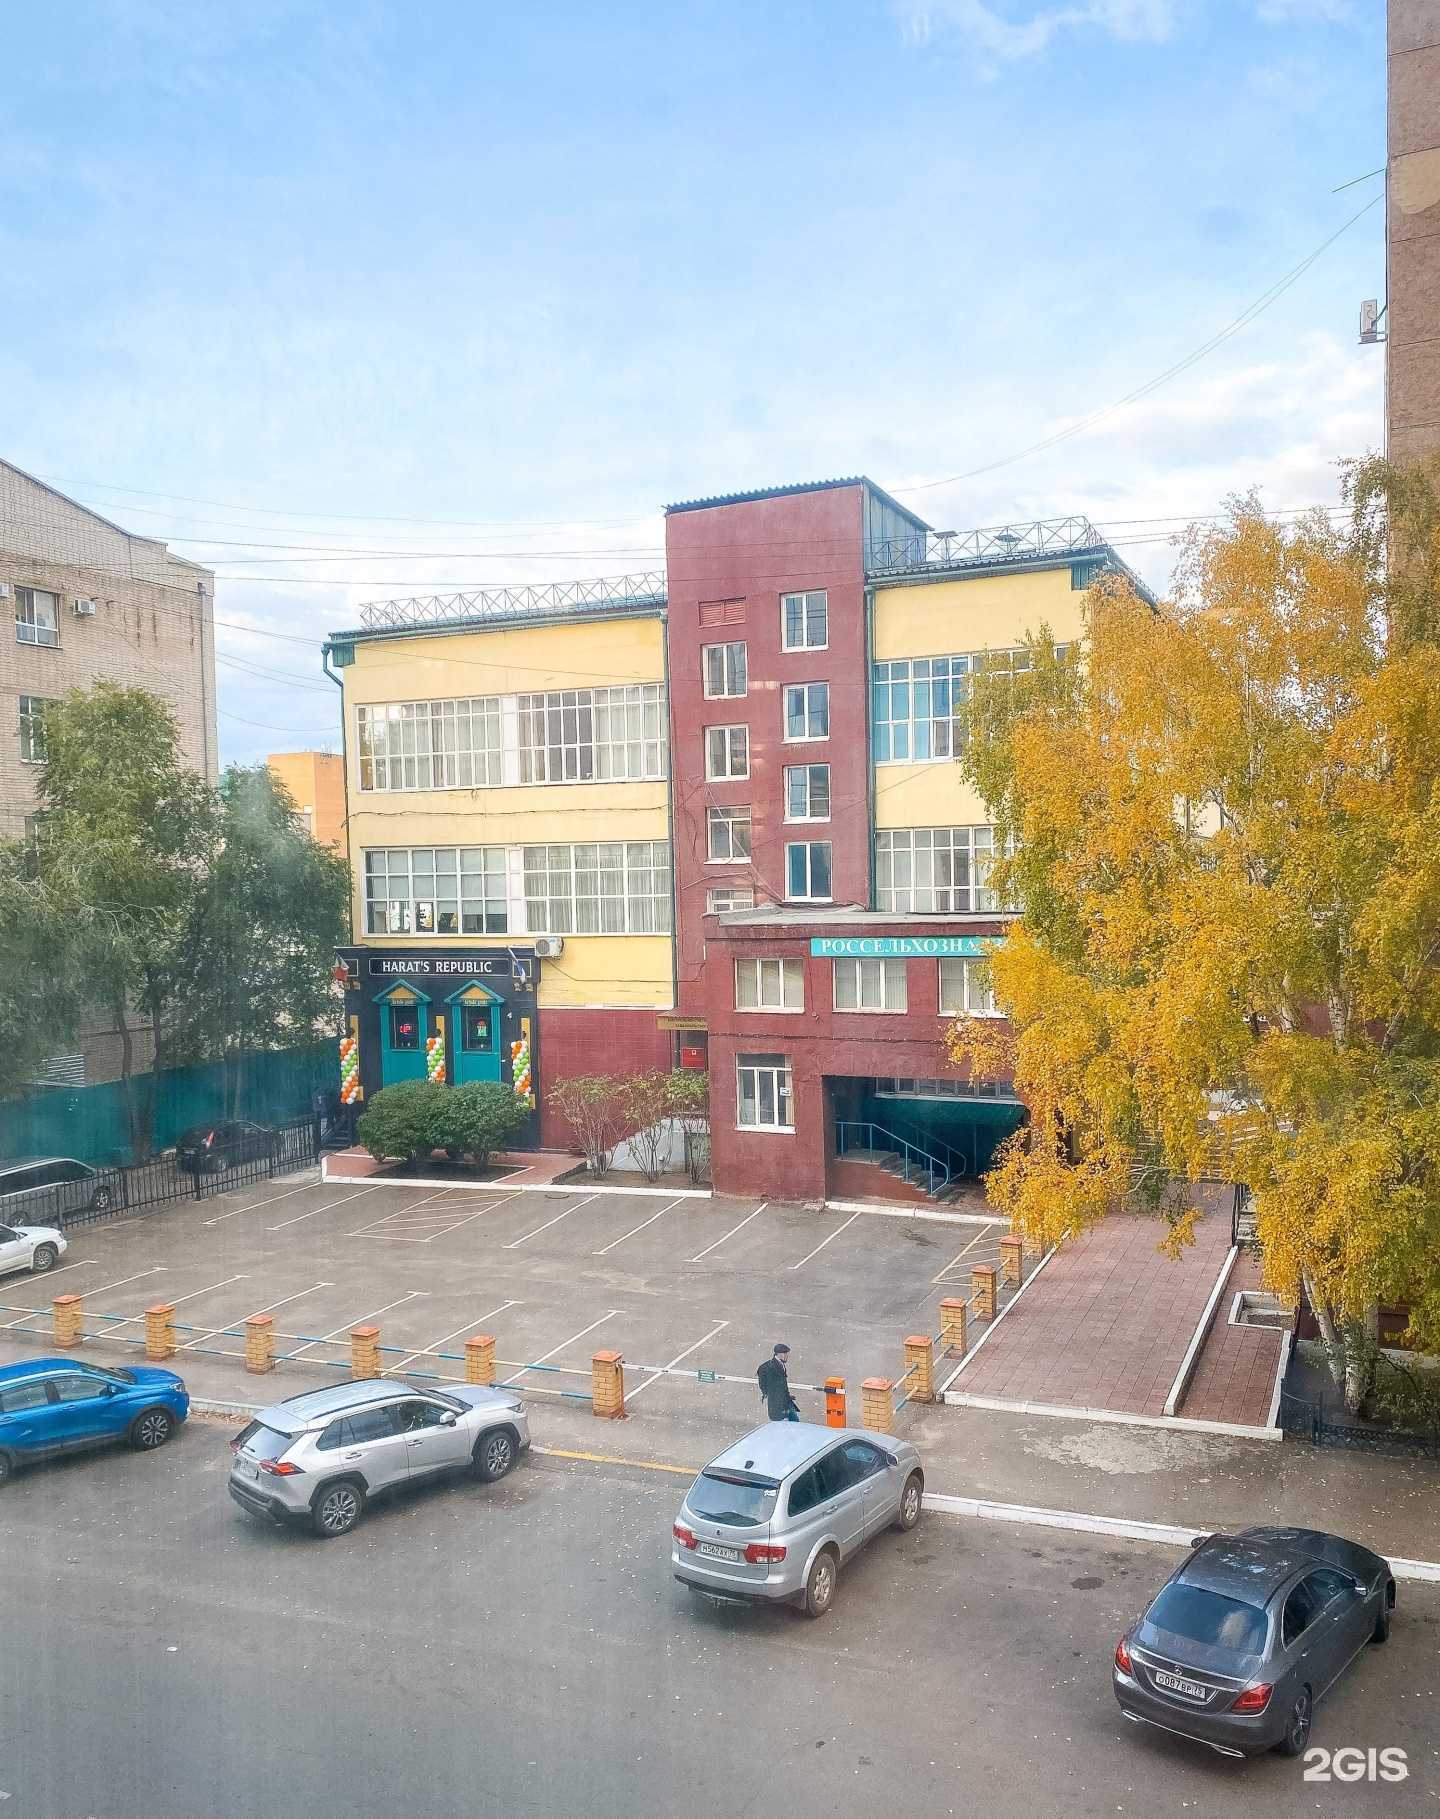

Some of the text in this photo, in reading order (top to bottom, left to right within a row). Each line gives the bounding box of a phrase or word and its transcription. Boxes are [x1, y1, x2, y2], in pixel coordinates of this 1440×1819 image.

[821, 938, 1004, 955] РОССЕЛЬХОЗНА
[382, 960, 493, 974] HARAT'S REPUBLIC
